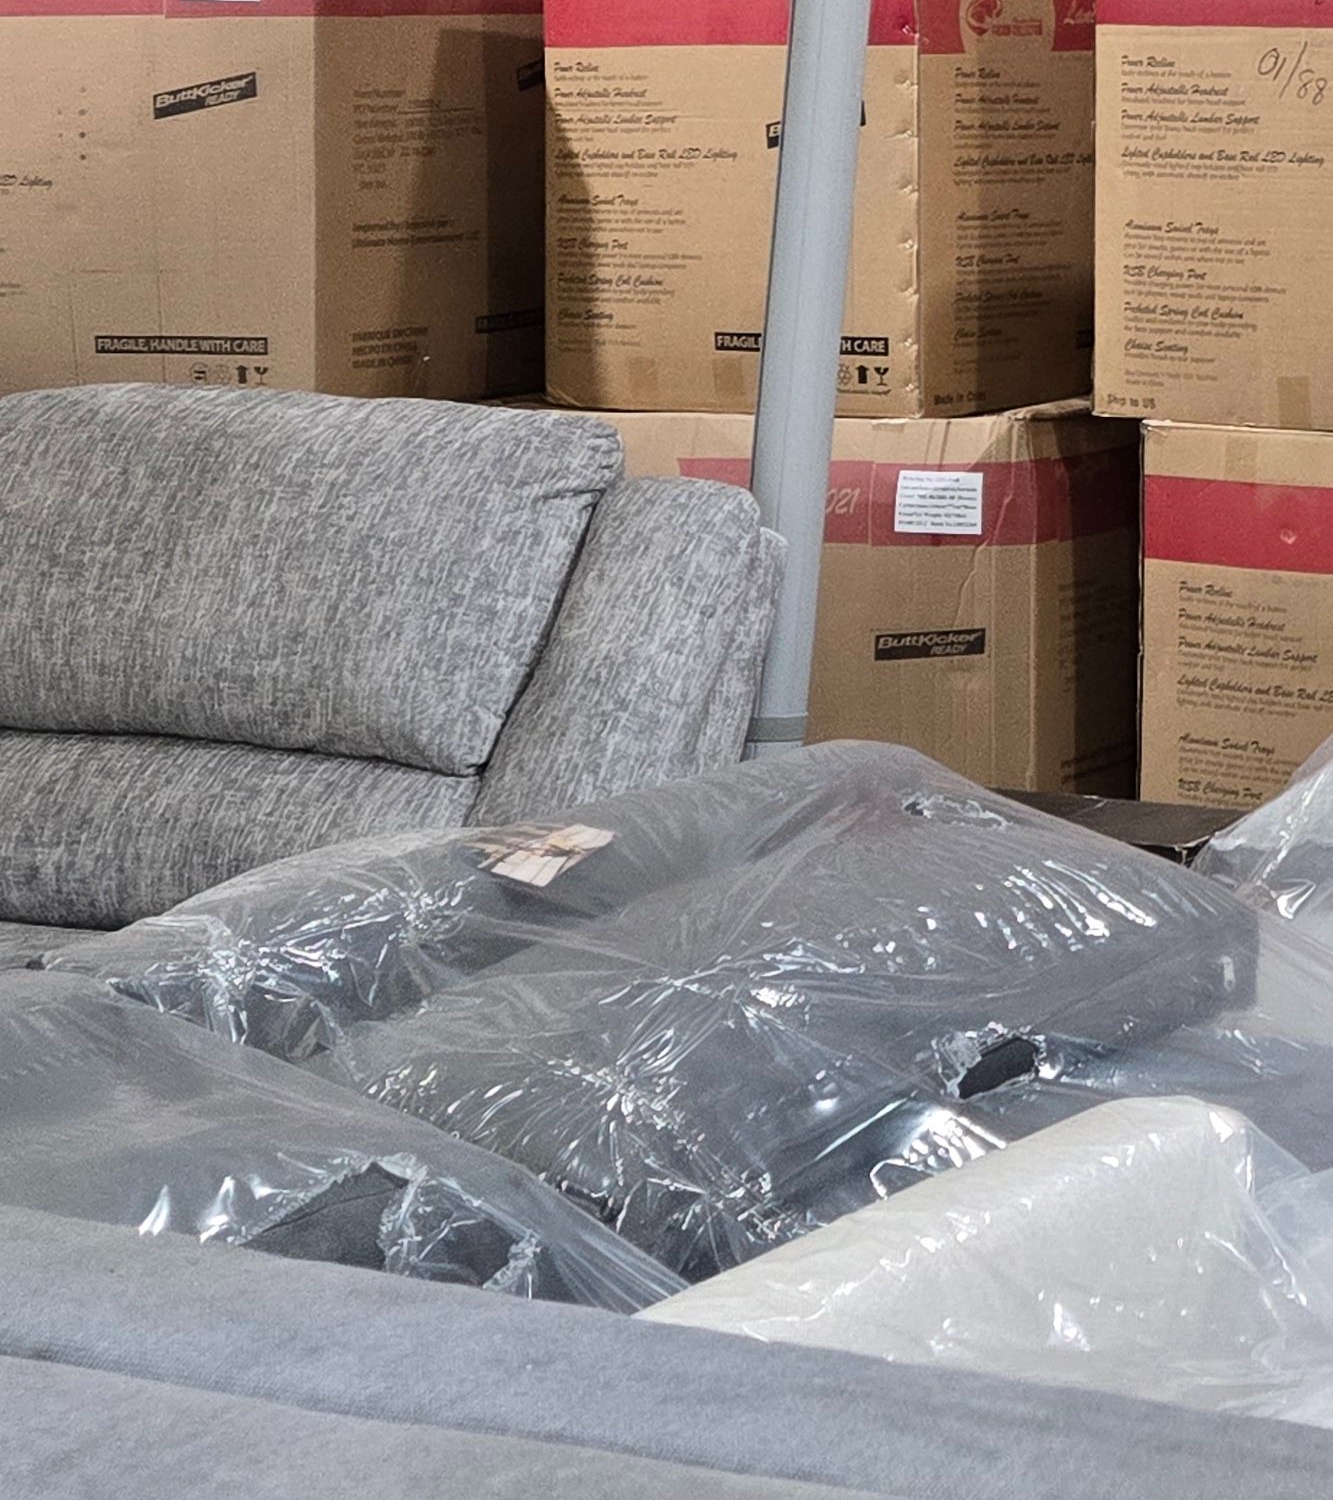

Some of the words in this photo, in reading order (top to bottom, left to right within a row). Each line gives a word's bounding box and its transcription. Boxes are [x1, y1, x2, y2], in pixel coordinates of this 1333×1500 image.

[1257, 40, 1328, 105] 01/88
[155, 74, 253, 108] ButtKicker
[204, 90, 239, 107] READY
[97, 338, 148, 353] FRAGILE,
[150, 338, 200, 352] HANDLE
[200, 338, 231, 352] WITH
[232, 339, 266, 353] CARE
[854, 339, 886, 353] CARE
[877, 630, 984, 649] ButtKicker
[930, 644, 966, 656] READY
